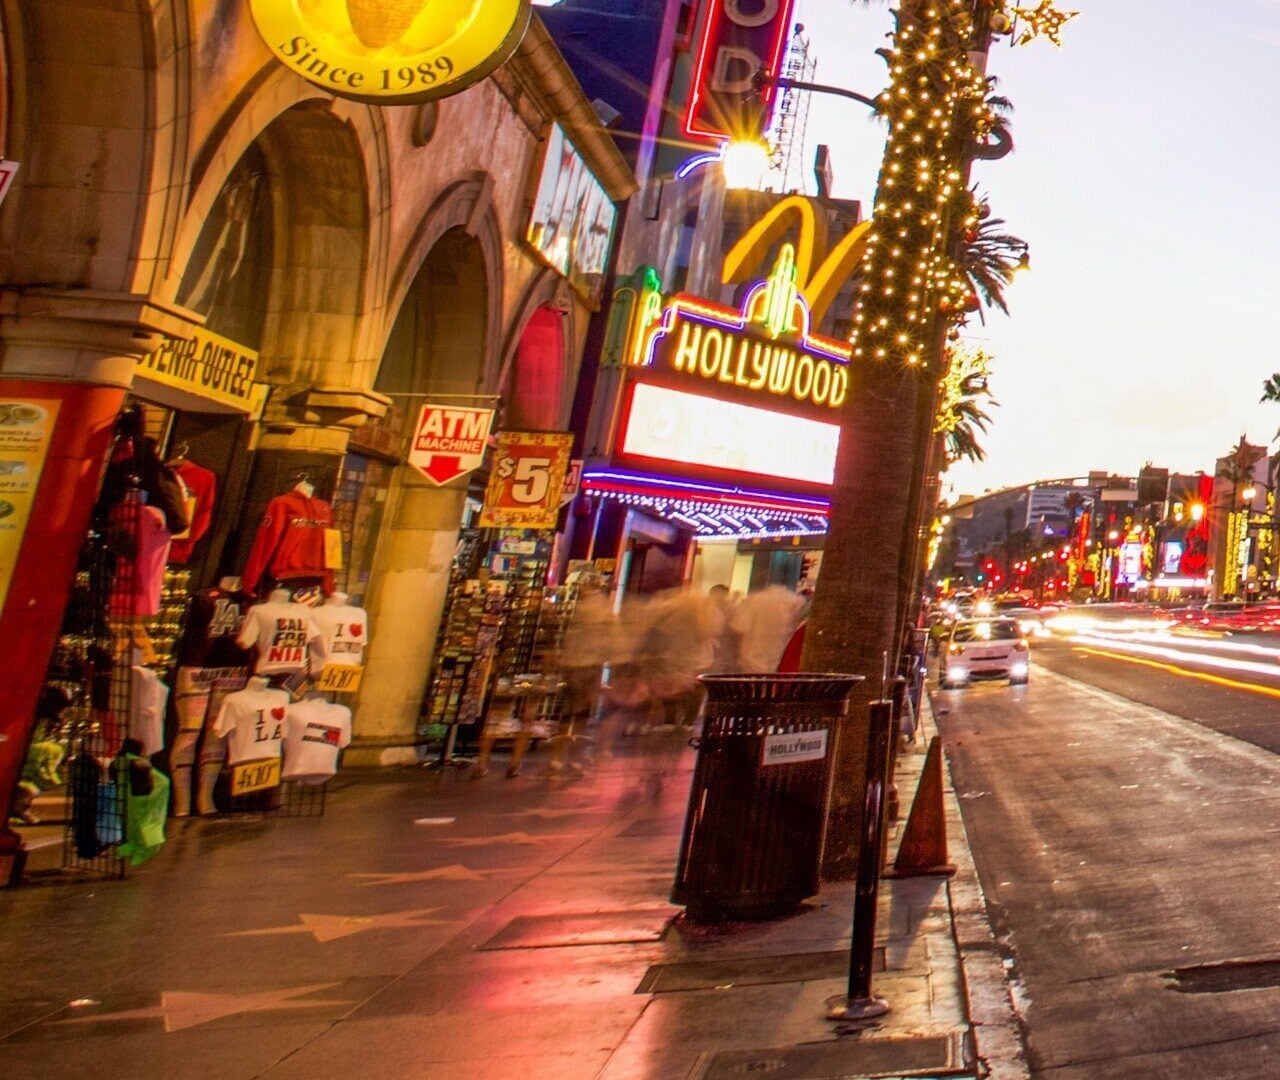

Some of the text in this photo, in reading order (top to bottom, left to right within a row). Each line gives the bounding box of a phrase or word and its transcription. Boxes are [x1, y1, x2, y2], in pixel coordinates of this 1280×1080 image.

[279, 35, 454, 90] Since 1989
[202, 341, 255, 400] OUTLET
[674, 322, 850, 408] HOLLYWOOD
[420, 409, 491, 440] ATM
[418, 437, 482, 453] MACHINE
[268, 648, 304, 662] NIA
[769, 738, 822, 756] HOLLYWOOD
